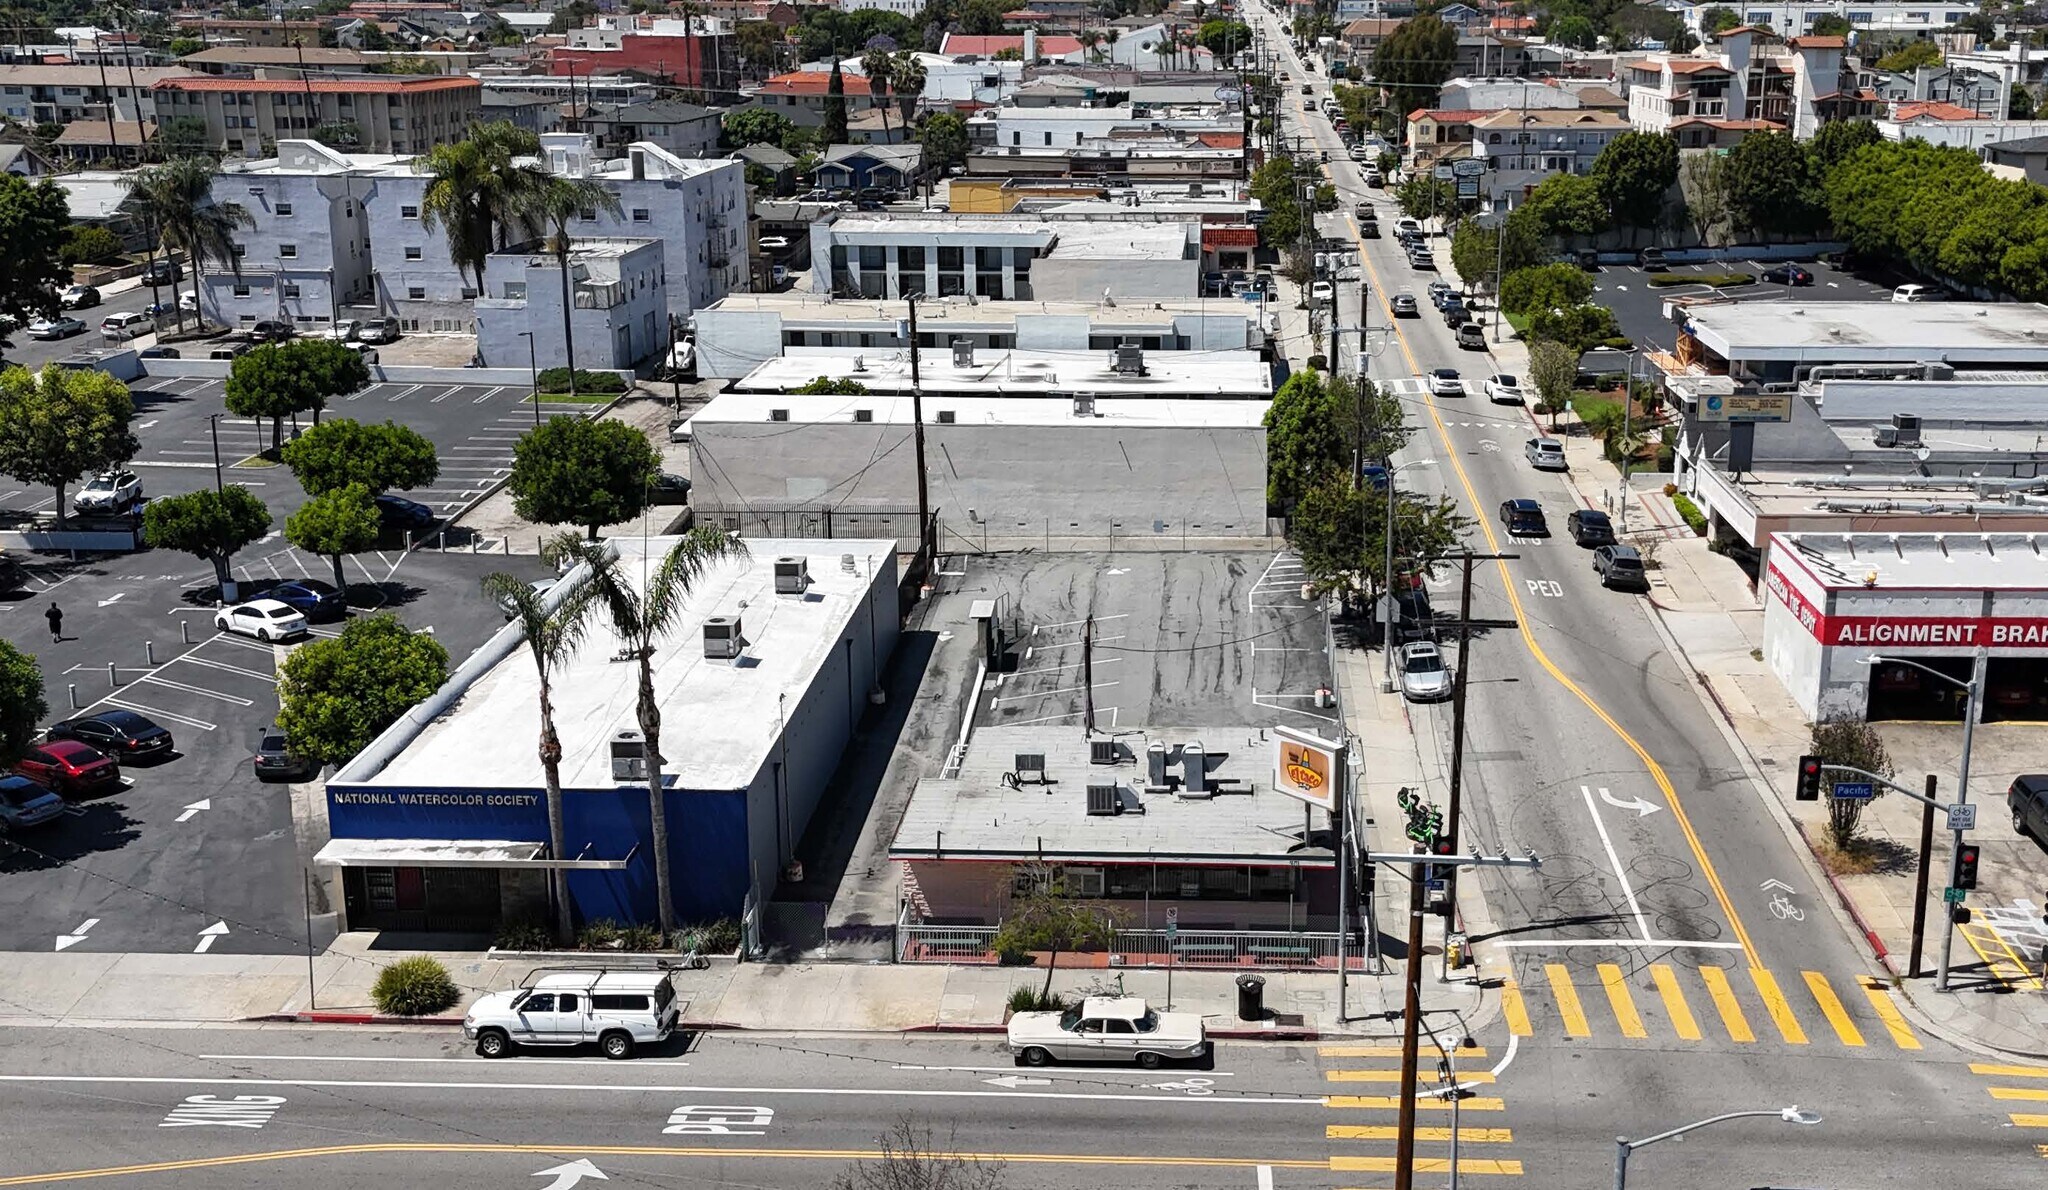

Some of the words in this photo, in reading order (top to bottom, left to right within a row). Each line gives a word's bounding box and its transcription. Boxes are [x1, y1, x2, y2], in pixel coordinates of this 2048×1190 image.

[1525, 579, 1564, 597] PED
[1838, 624, 1978, 642] ALIGNMENT
[334, 793, 396, 804] NATIONAL
[398, 794, 484, 805] WATERCOLOR
[487, 795, 538, 806] SOCIETY
[1837, 786, 1869, 796] Pacific
[158, 1094, 287, 1128] XING
[661, 1105, 775, 1135] PED
